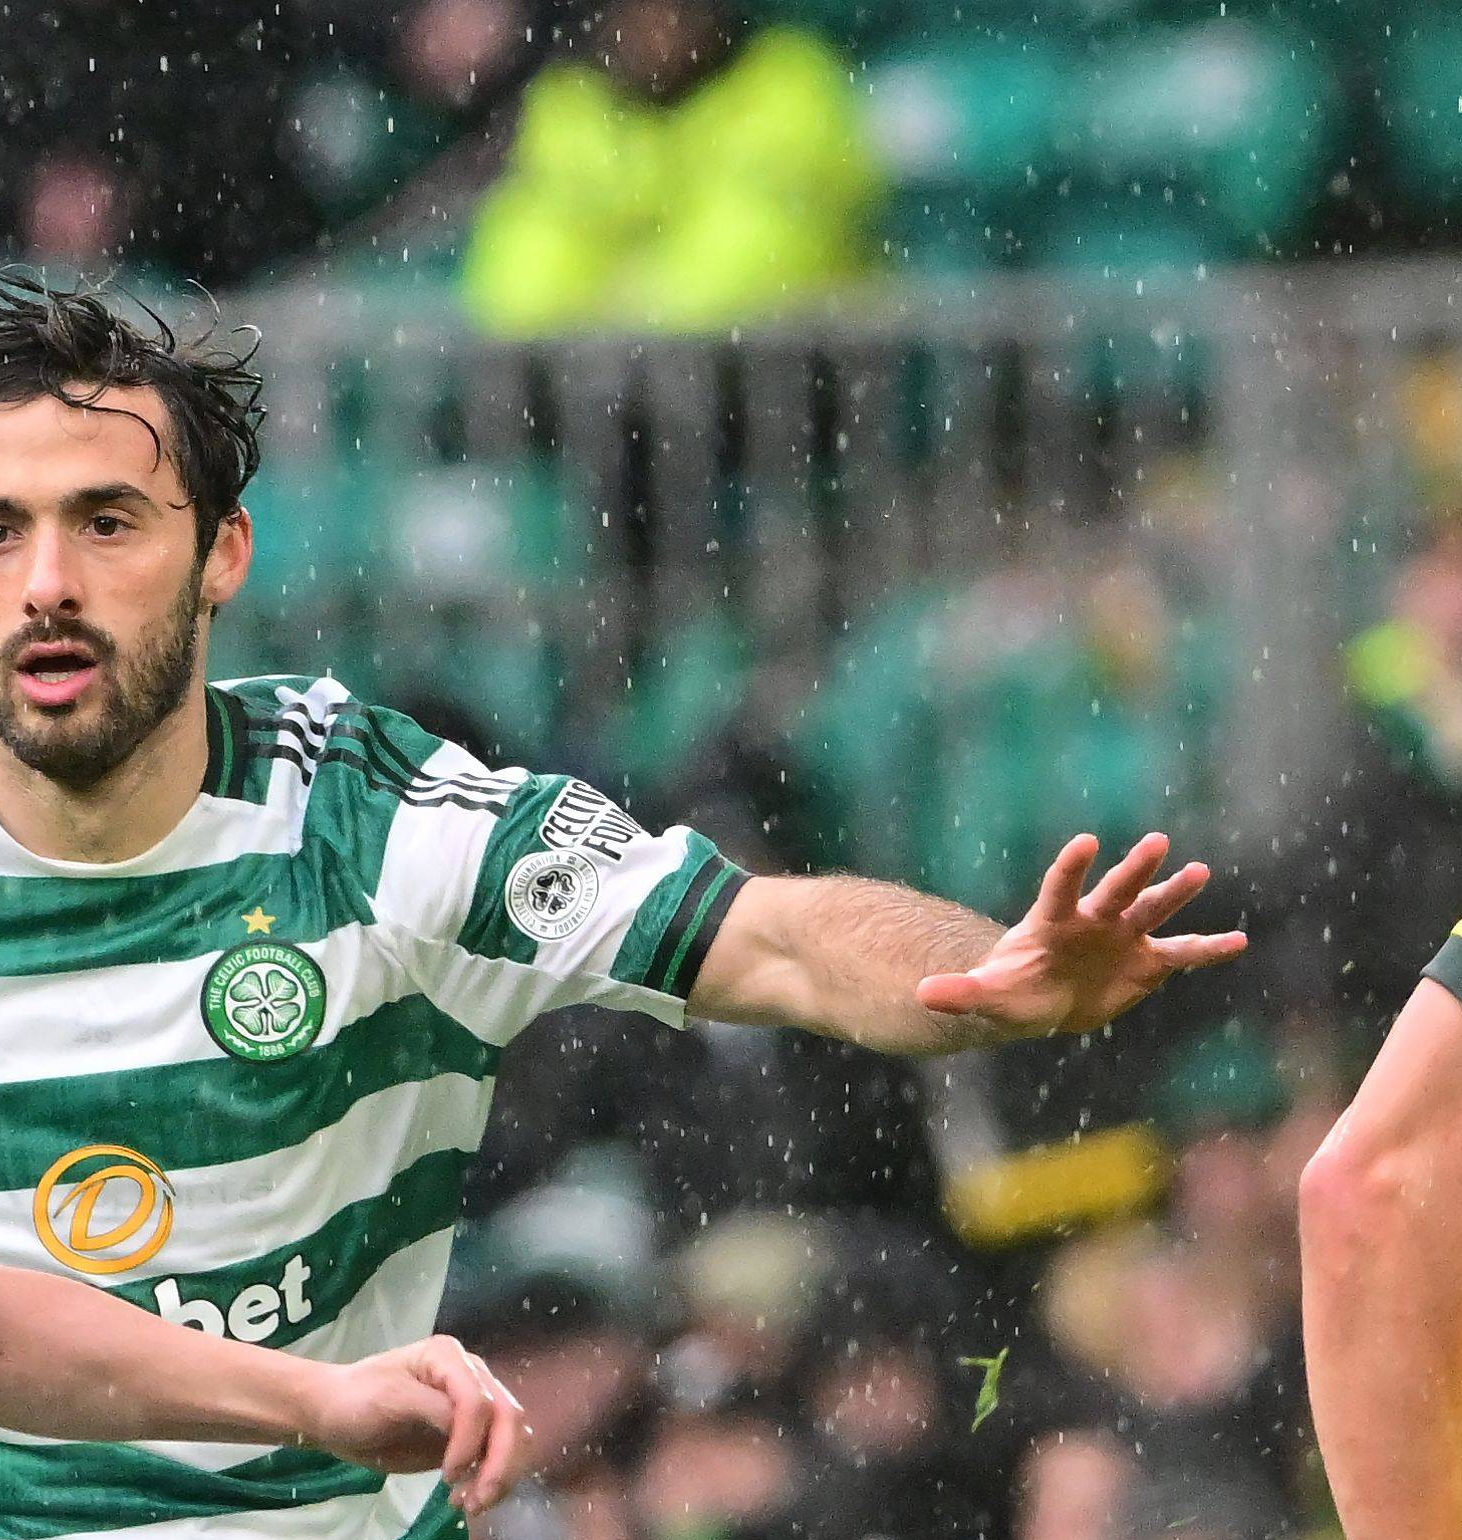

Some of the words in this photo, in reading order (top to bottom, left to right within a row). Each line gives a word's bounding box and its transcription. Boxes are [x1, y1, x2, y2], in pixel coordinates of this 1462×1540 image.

[209, 985, 223, 1010] THE
[217, 954, 246, 987] CELTIC
[246, 947, 303, 973] FOOTBALL
[301, 968, 322, 999] CLUB
[154, 1277, 313, 1343] bet
